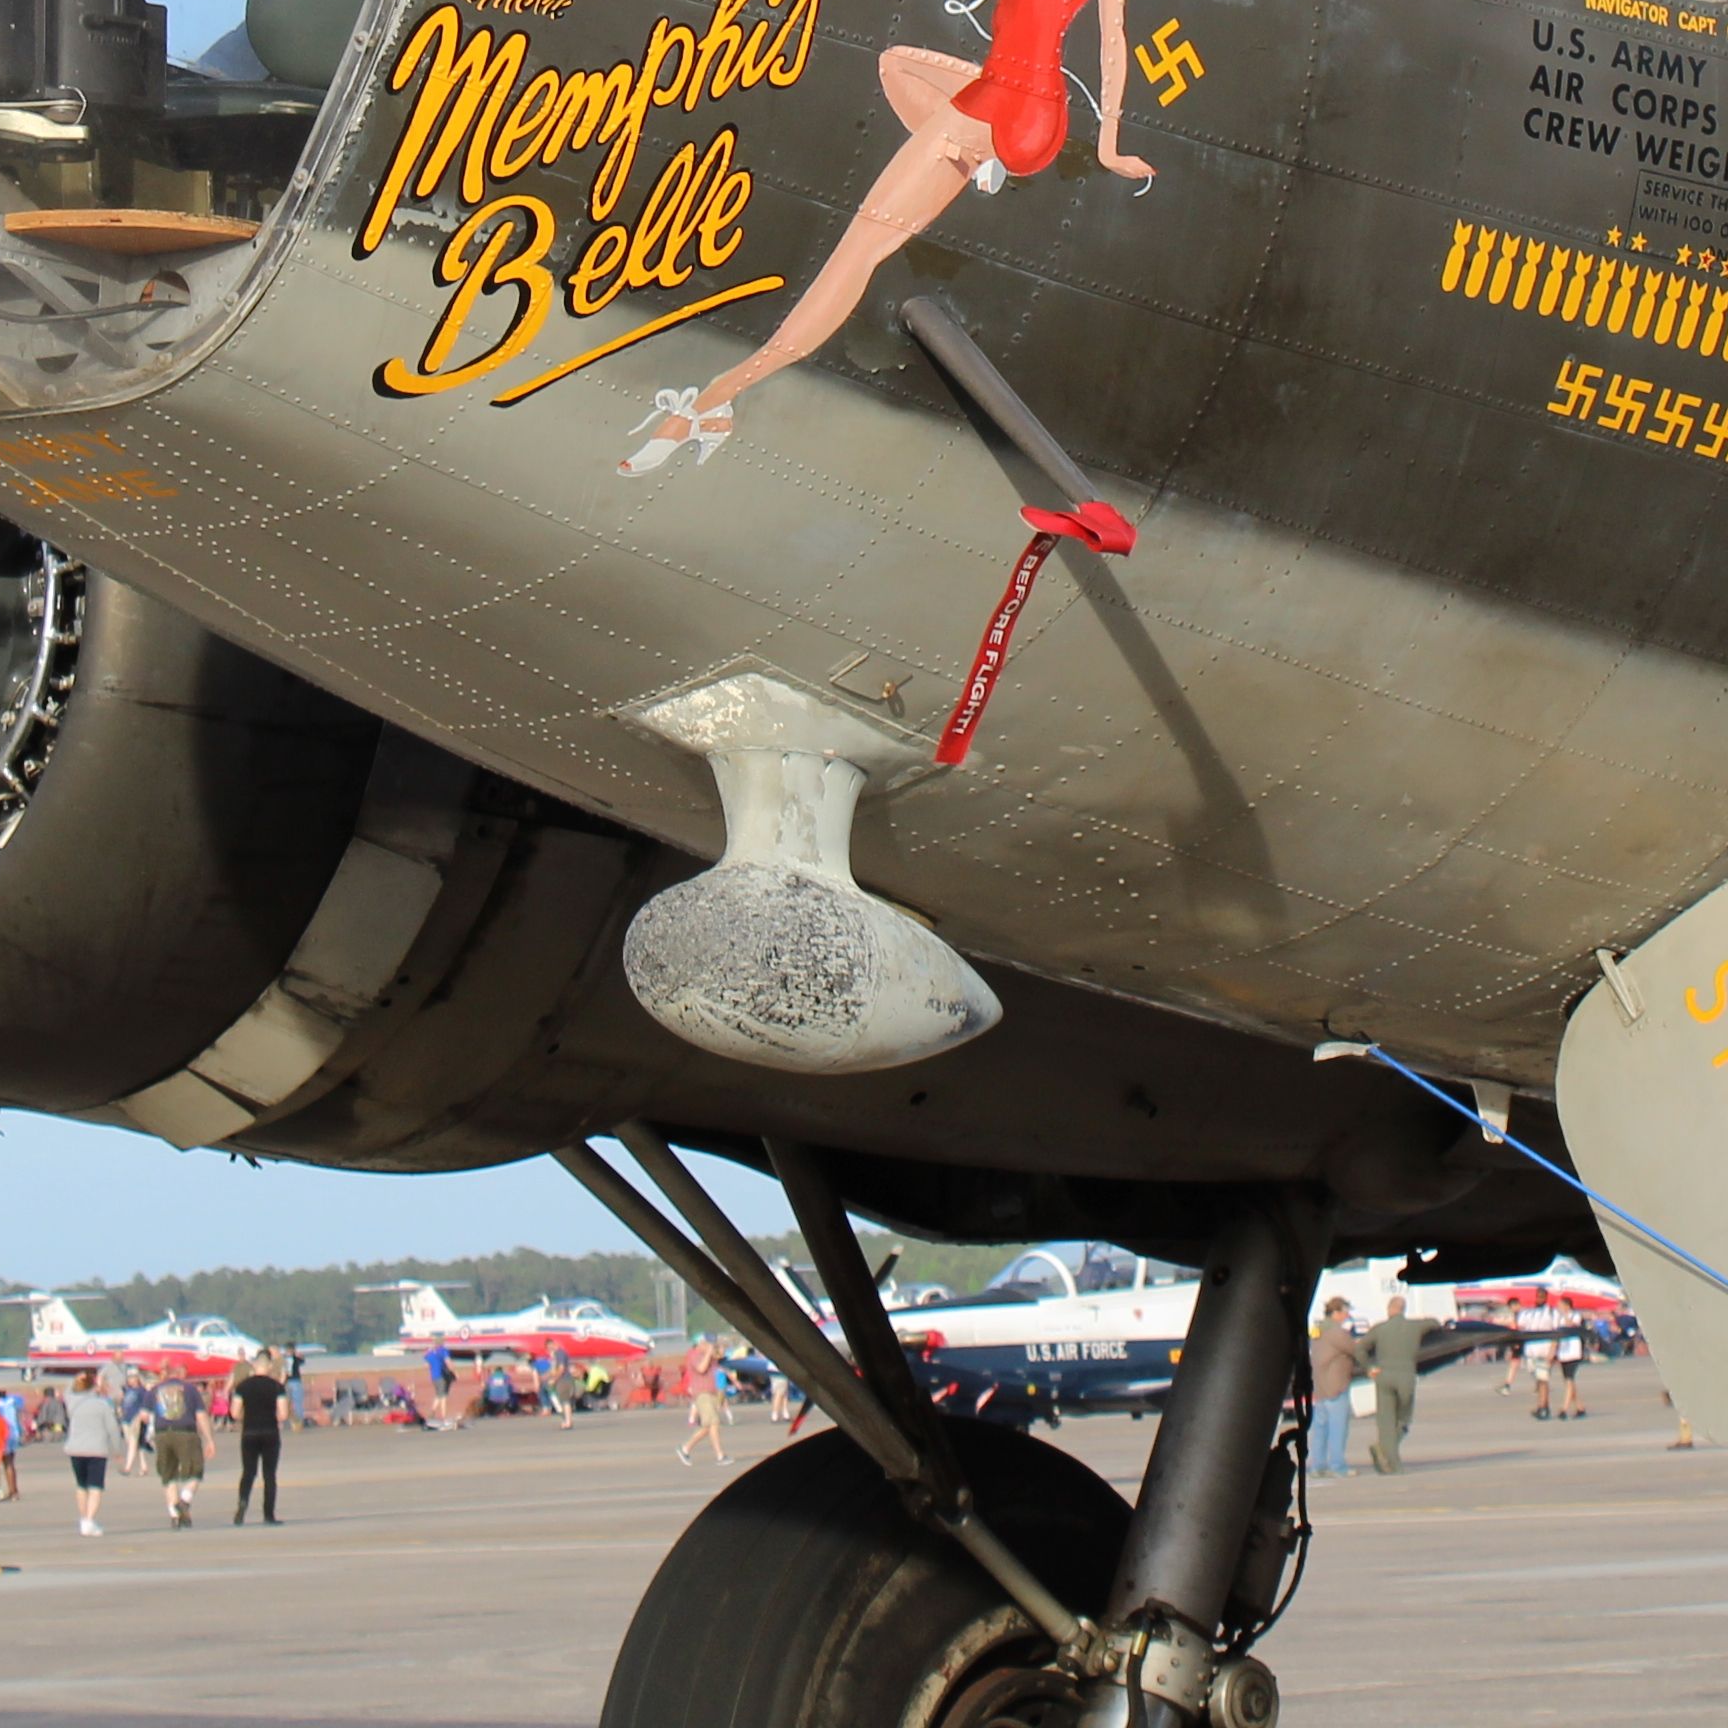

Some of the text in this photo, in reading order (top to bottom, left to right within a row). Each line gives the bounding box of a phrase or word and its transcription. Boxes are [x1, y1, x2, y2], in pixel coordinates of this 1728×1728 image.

[1678, 9, 1717, 36] CAPT.
[1532, 19, 1595, 63] U.S.
[1611, 40, 1708, 88] ARMY
[1529, 65, 1585, 106] AIR
[1611, 83, 1718, 137] CORPS
[1523, 106, 1621, 156] CREW
[1643, 179, 1704, 207] SERVICE
[1638, 205, 1679, 226] WITH
[1683, 215, 1713, 235] 100
[373, 123, 753, 400] Belle
[952, 554, 1039, 735] BEFORE FLIGHT!
[1056, 1343, 1079, 1360] AIR
[1082, 1341, 1128, 1360] FORCE
